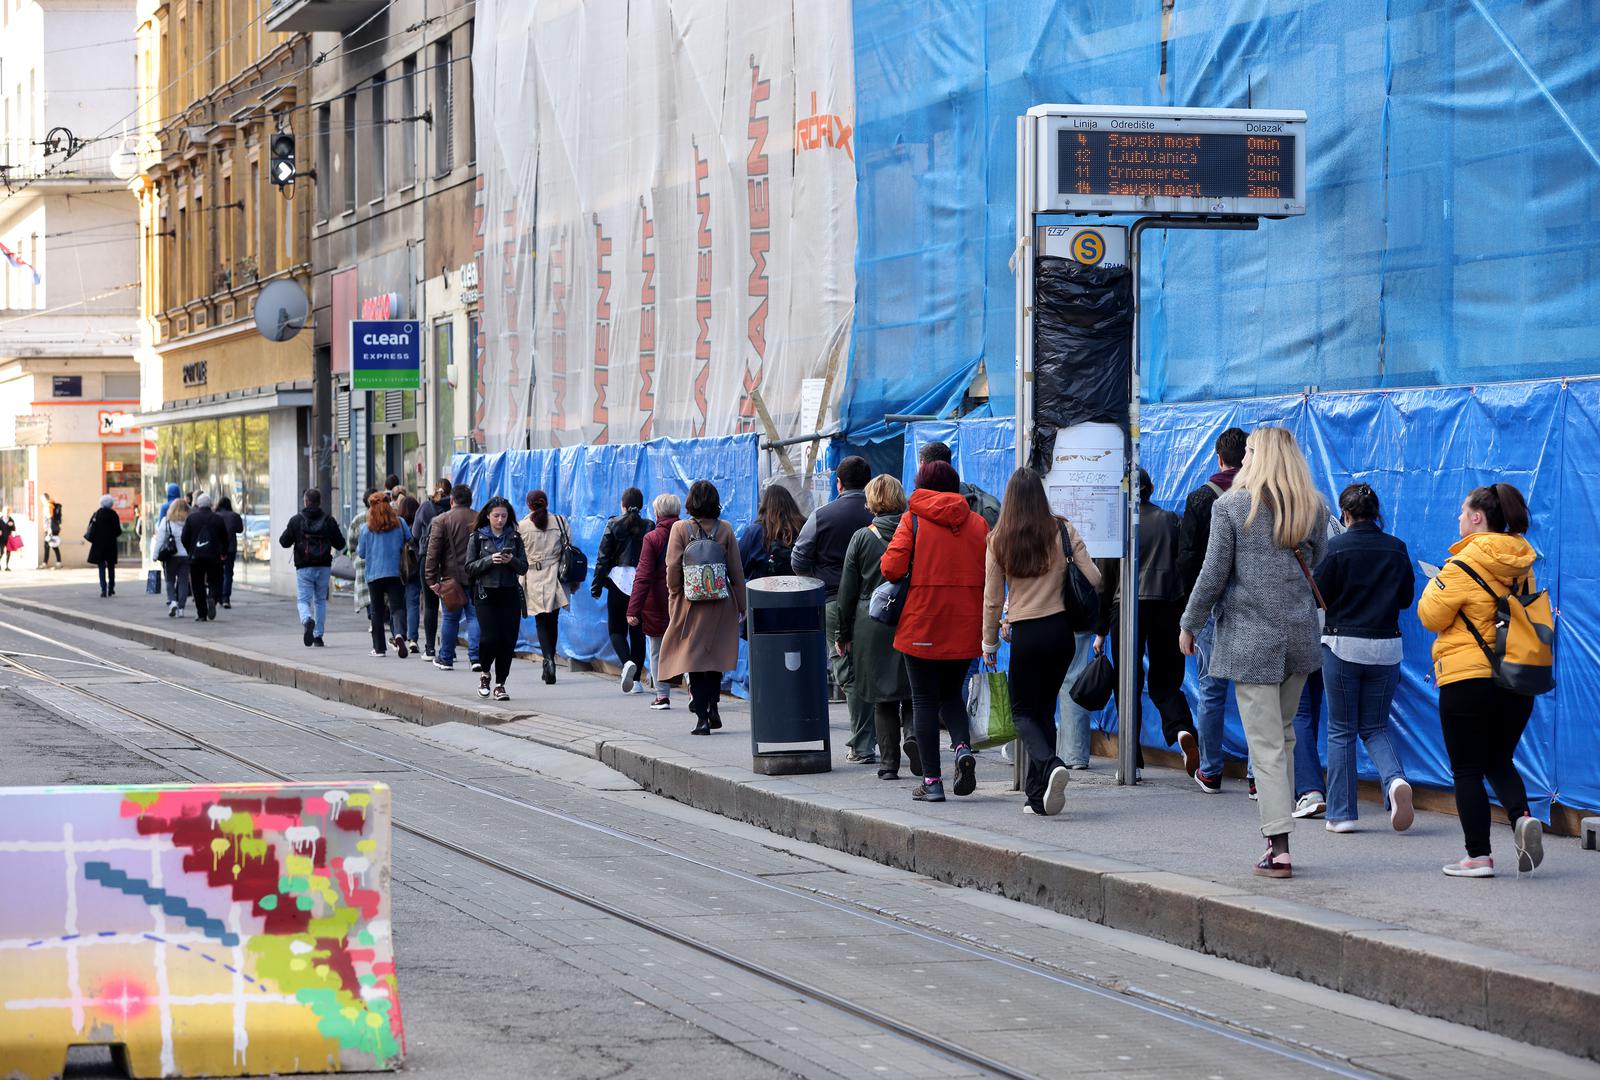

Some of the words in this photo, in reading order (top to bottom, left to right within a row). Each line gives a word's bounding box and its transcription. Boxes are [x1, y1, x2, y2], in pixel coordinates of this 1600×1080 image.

[1073, 119, 1098, 130] Linija
[1110, 119, 1155, 130] Odredište
[1246, 123, 1282, 132] Dolazak
[1078, 133, 1086, 145] 4
[1108, 134, 1160, 148] Savski
[1164, 136, 1201, 149] most
[1247, 137, 1280, 150] 0min
[1074, 149, 1091, 161] 12
[1108, 150, 1197, 164] Ljubljanica
[1247, 153, 1280, 166] 0min
[1075, 165, 1089, 177] 11
[1247, 168, 1280, 182] 2min
[1075, 181, 1091, 193] 14
[1108, 181, 1160, 195] Savski
[1164, 183, 1201, 195] most
[1047, 227, 1070, 236] ZET
[1081, 238, 1097, 260] S
